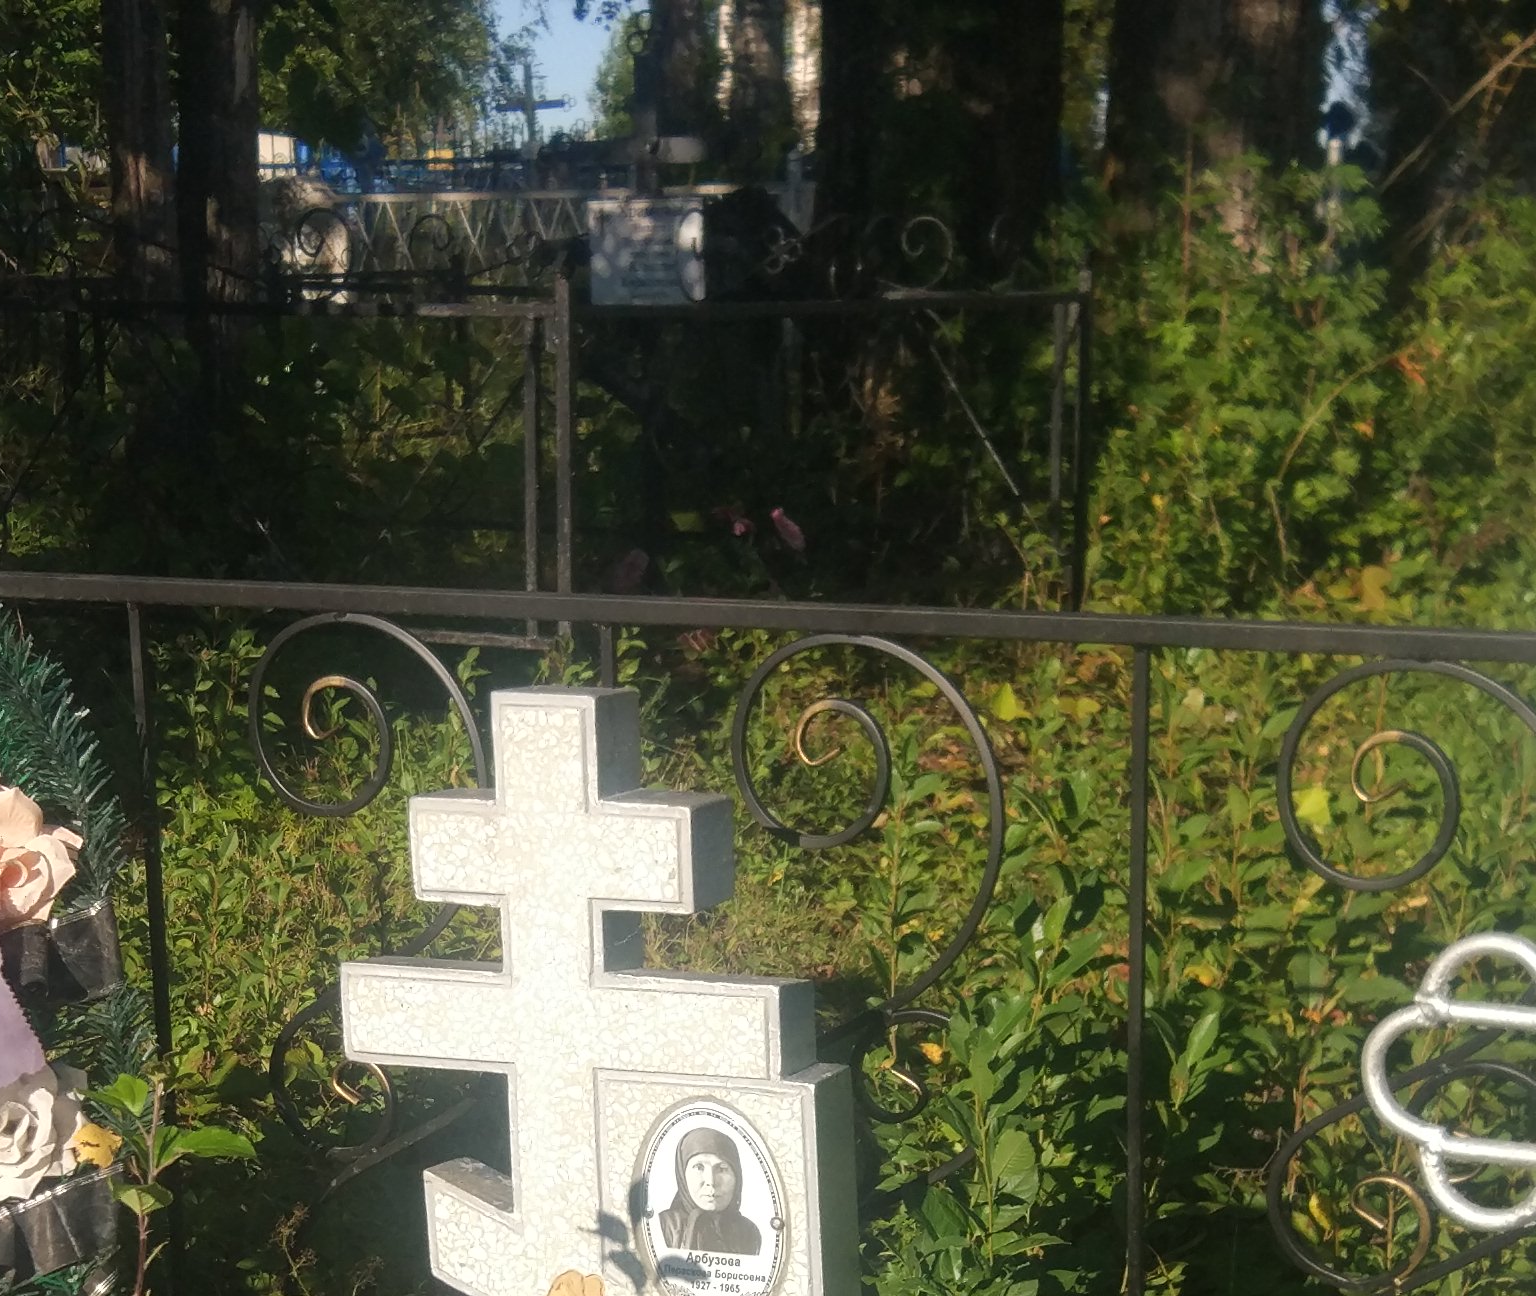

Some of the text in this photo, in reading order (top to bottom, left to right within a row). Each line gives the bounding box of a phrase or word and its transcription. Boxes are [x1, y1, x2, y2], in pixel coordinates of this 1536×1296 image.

[686, 1251, 741, 1268] Арбузова
[714, 1269, 766, 1283] Борисовна
[691, 1281, 711, 1291] 1927
[720, 1283, 741, 1293] 1965
